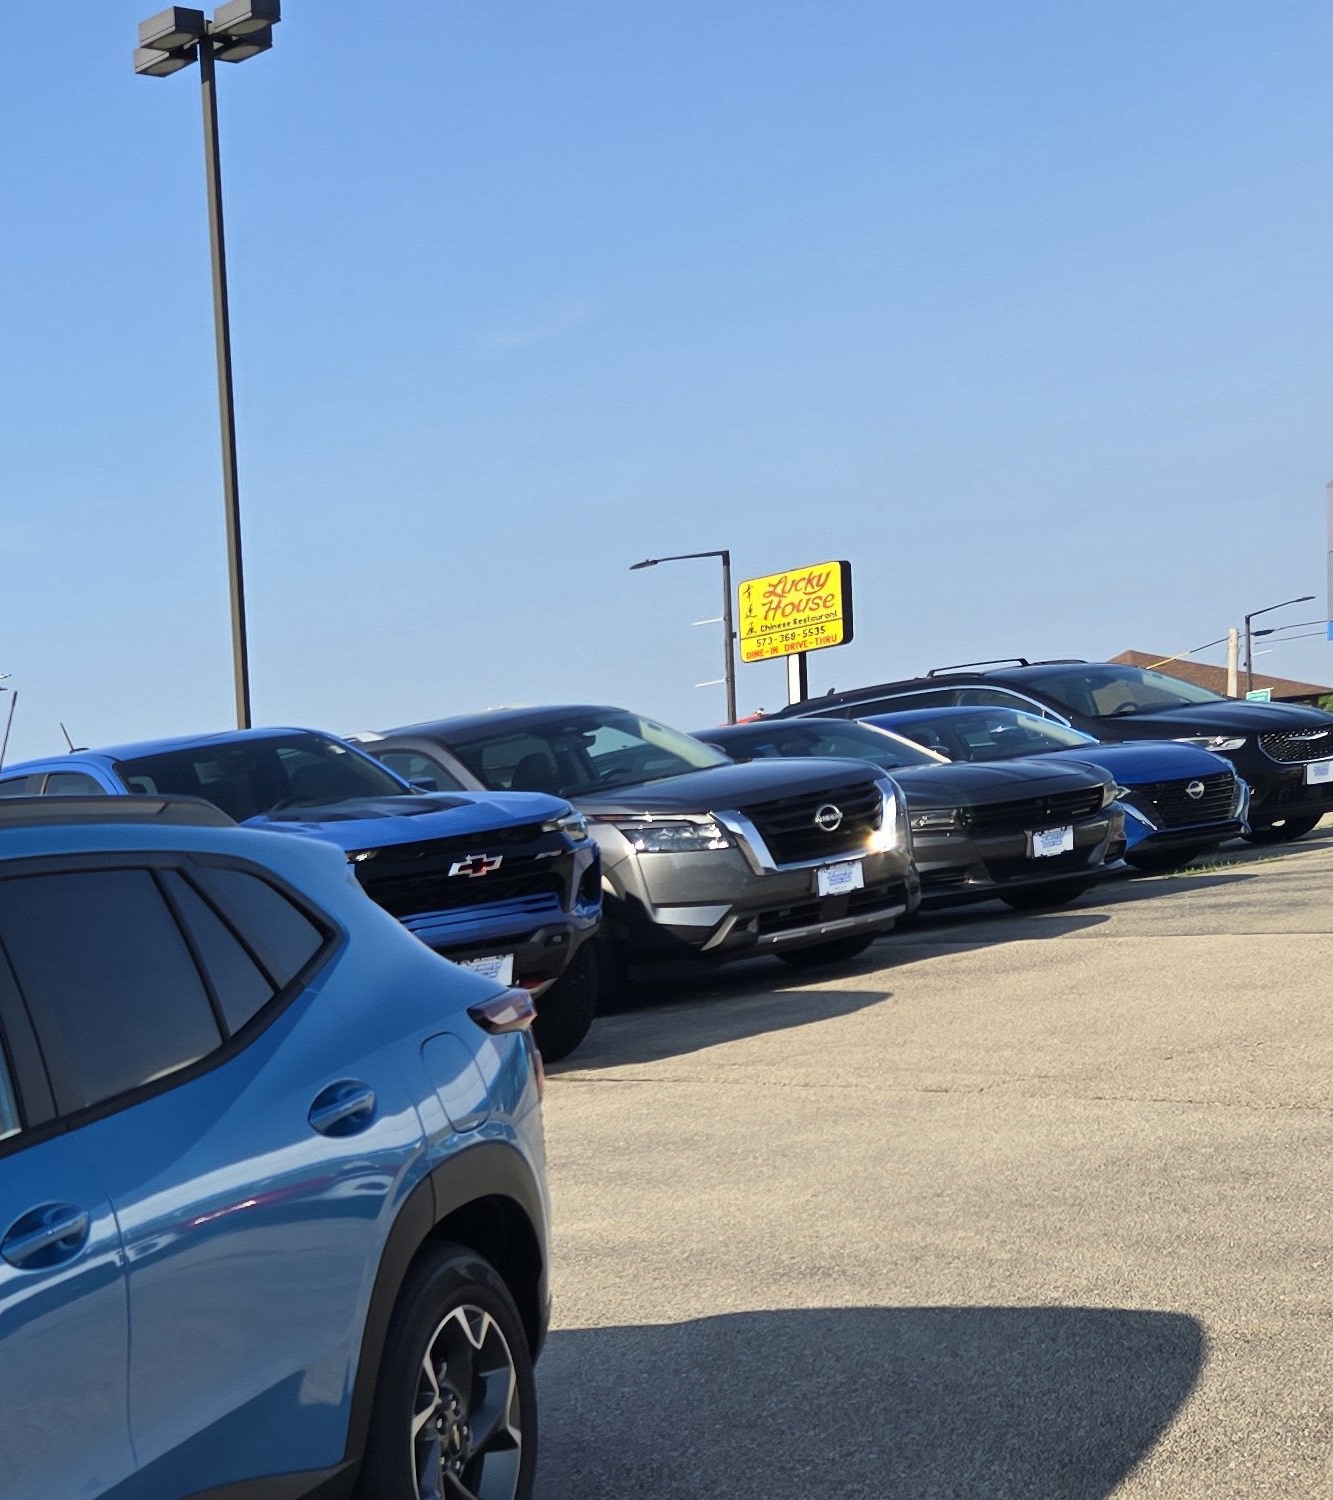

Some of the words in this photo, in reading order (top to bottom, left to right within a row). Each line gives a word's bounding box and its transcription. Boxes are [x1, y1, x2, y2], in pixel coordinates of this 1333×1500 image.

[763, 570, 832, 598] Lucky
[760, 621, 791, 632] Chinese
[746, 645, 779, 660] DINE-IN
[784, 633, 838, 652] DRIVE-THRU
